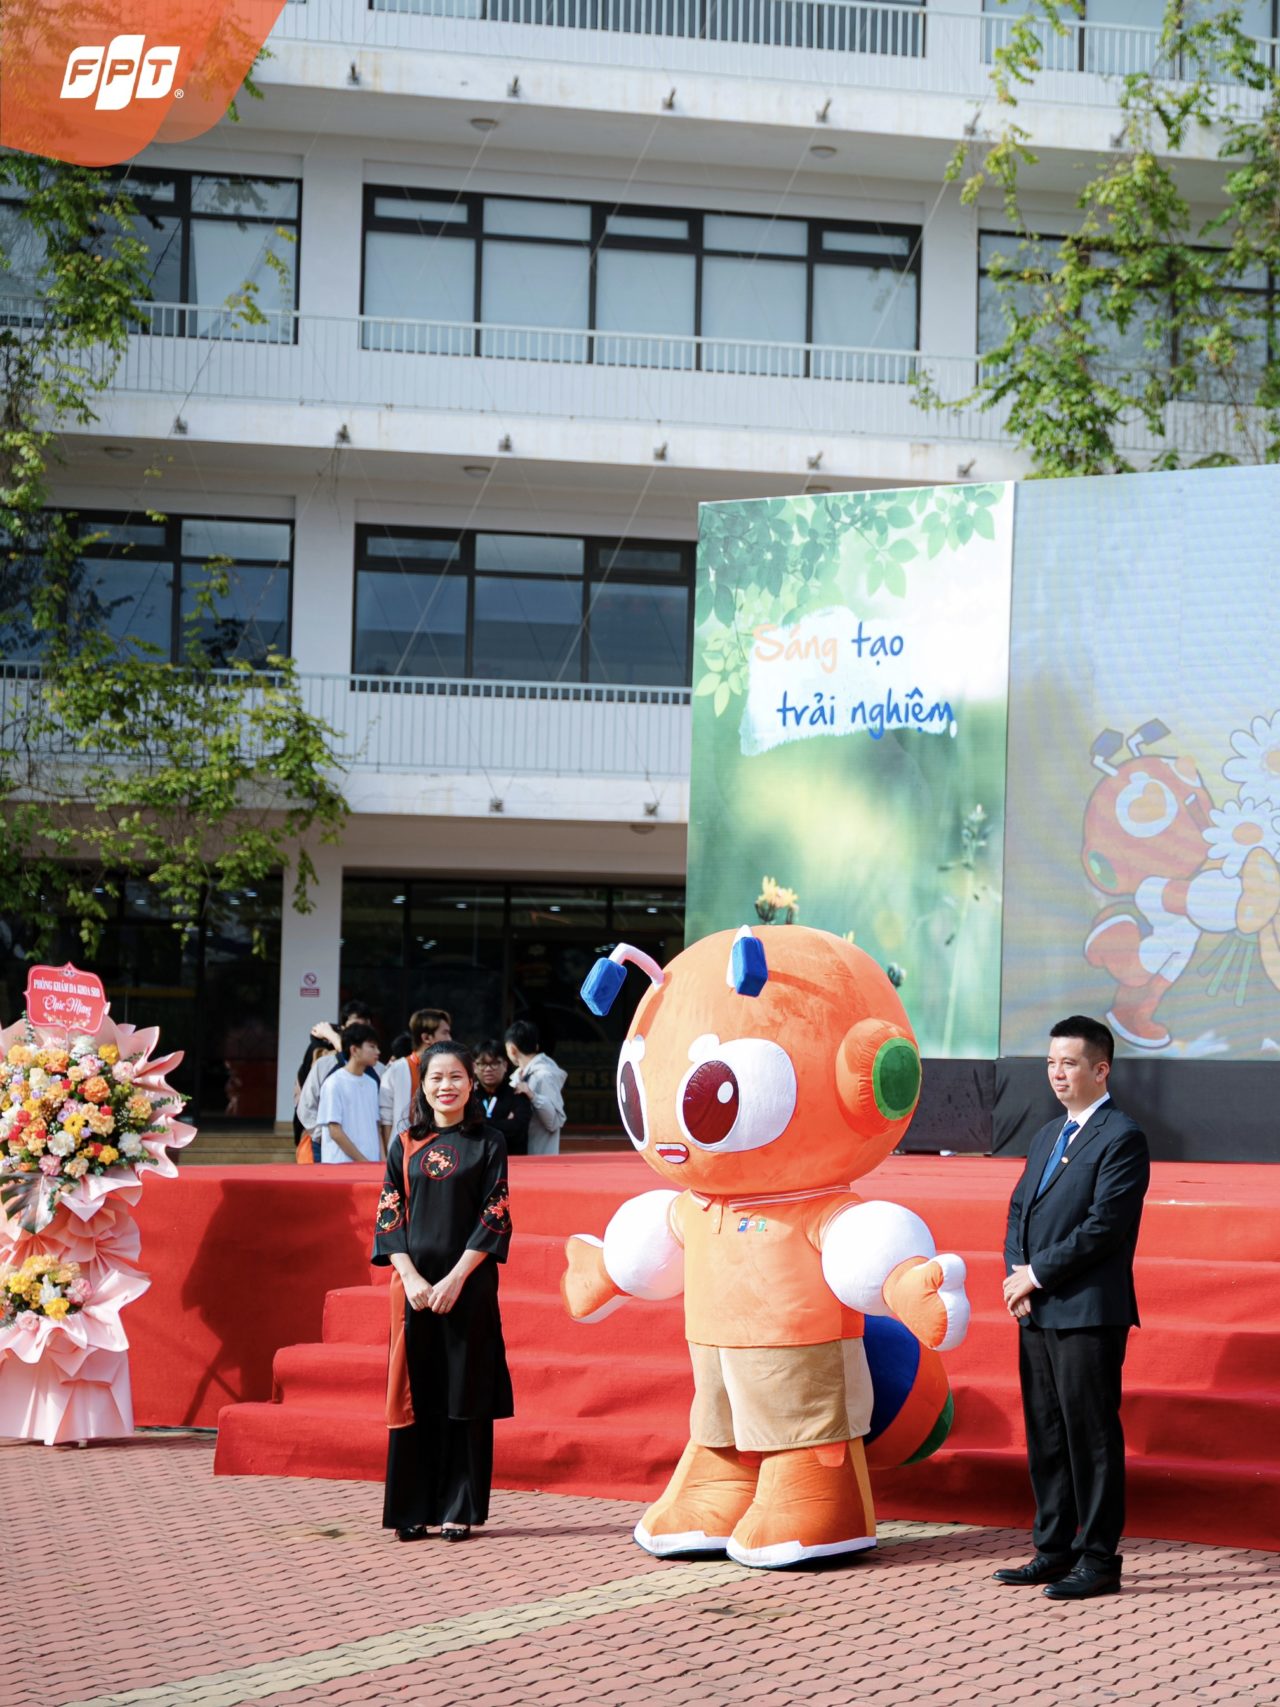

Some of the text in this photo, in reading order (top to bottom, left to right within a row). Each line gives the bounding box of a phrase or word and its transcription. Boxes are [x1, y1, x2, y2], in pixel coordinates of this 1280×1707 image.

[752, 621, 904, 674] Sáng tạo
[776, 686, 955, 740] trải nghiệm
[738, 1218, 767, 1232] FPT
